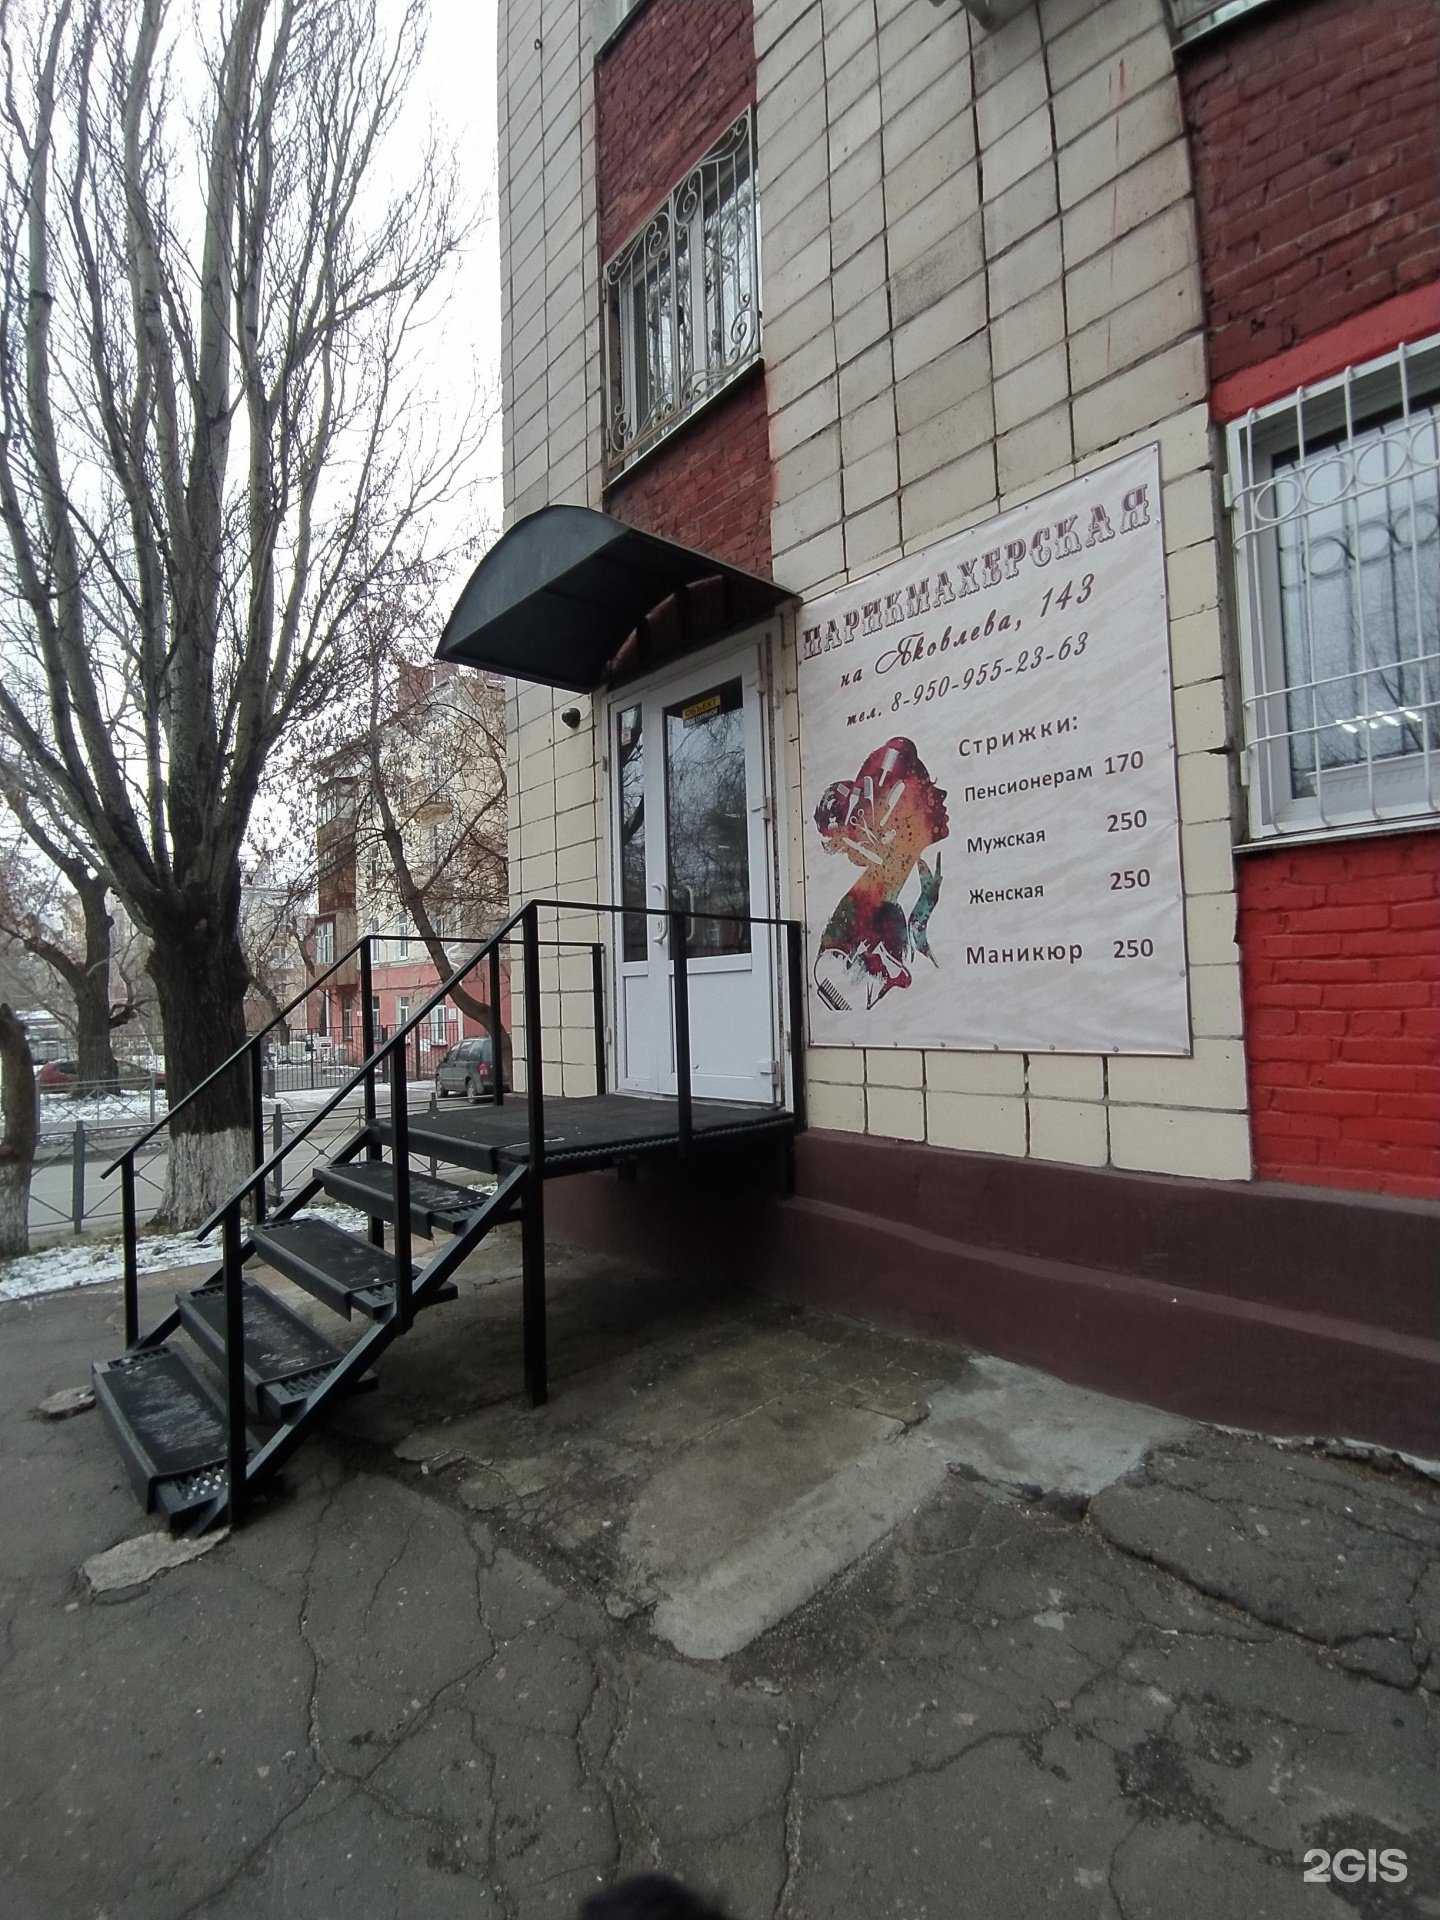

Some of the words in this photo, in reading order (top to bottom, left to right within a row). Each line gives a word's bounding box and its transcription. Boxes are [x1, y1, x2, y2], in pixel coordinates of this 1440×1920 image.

[802, 485, 1151, 659] ПАРИКМАХЕРСКАЯ
[841, 669, 862, 687] на
[875, 610, 1022, 674] Яковлева,
[1040, 573, 1094, 618] 143
[847, 710, 882, 727] тел.
[891, 632, 1089, 712] 8-950-955-23-63
[959, 716, 1079, 756] Стрижки:
[965, 764, 1092, 802] Пенсионерам
[1104, 751, 1144, 775] 170
[967, 830, 1046, 853] Мужская
[1107, 810, 1147, 832] 250
[969, 884, 1044, 904] Женская
[1110, 869, 1151, 890] 250
[967, 943, 1082, 964] Маникюр
[1113, 938, 1154, 959] 250
